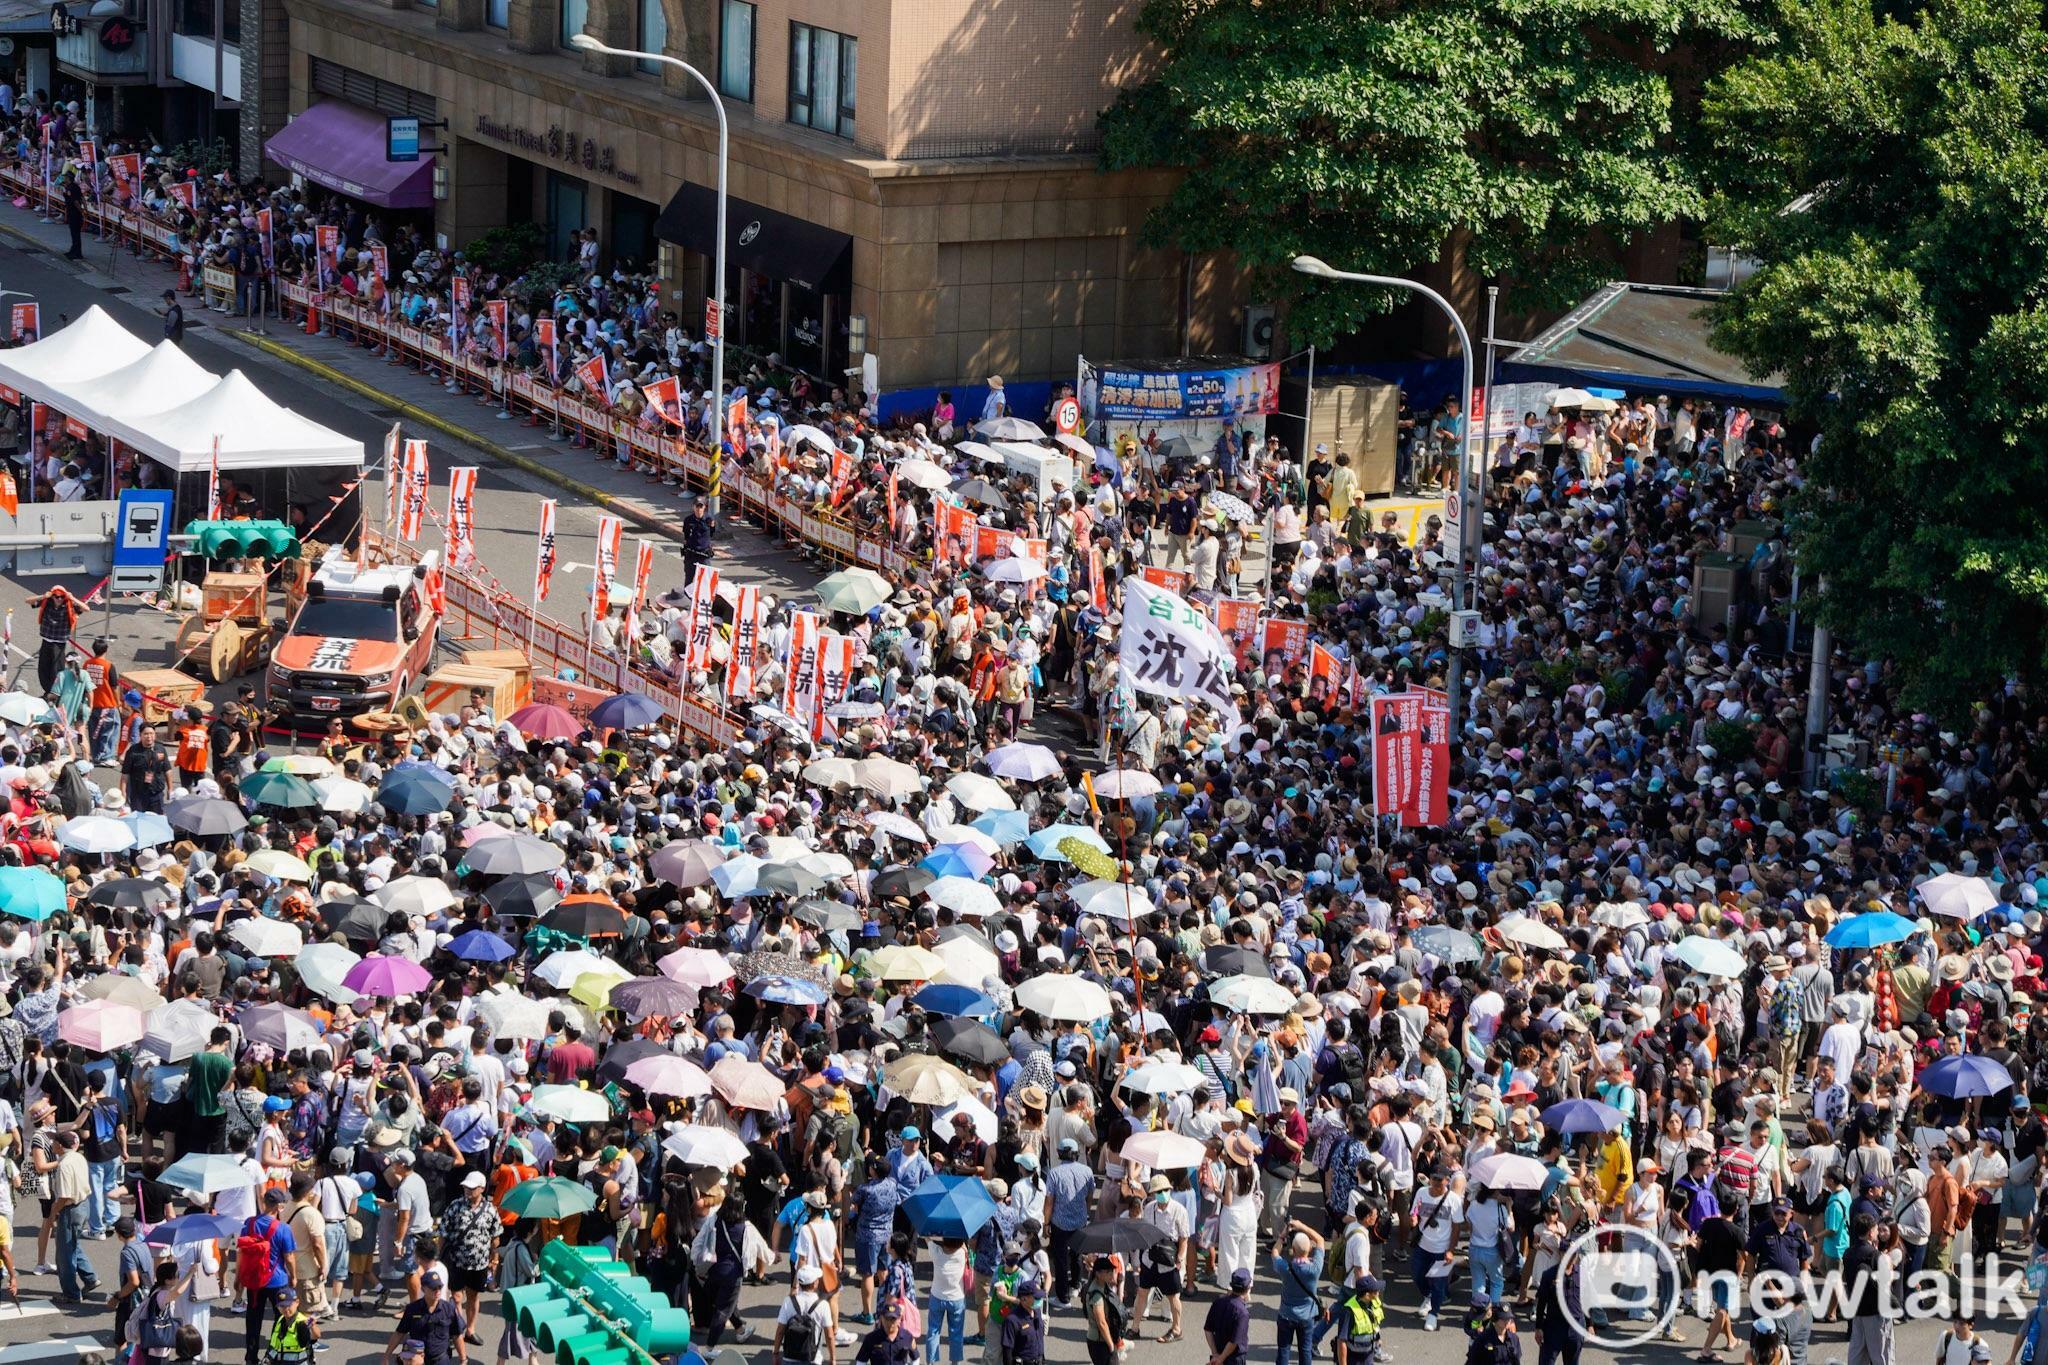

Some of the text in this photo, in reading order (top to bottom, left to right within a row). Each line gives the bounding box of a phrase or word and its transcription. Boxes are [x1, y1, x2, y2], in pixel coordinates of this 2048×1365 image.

[1062, 407, 1075, 424] 15
[1148, 595, 1203, 632] 台北
[308, 639, 359, 671] 洋流
